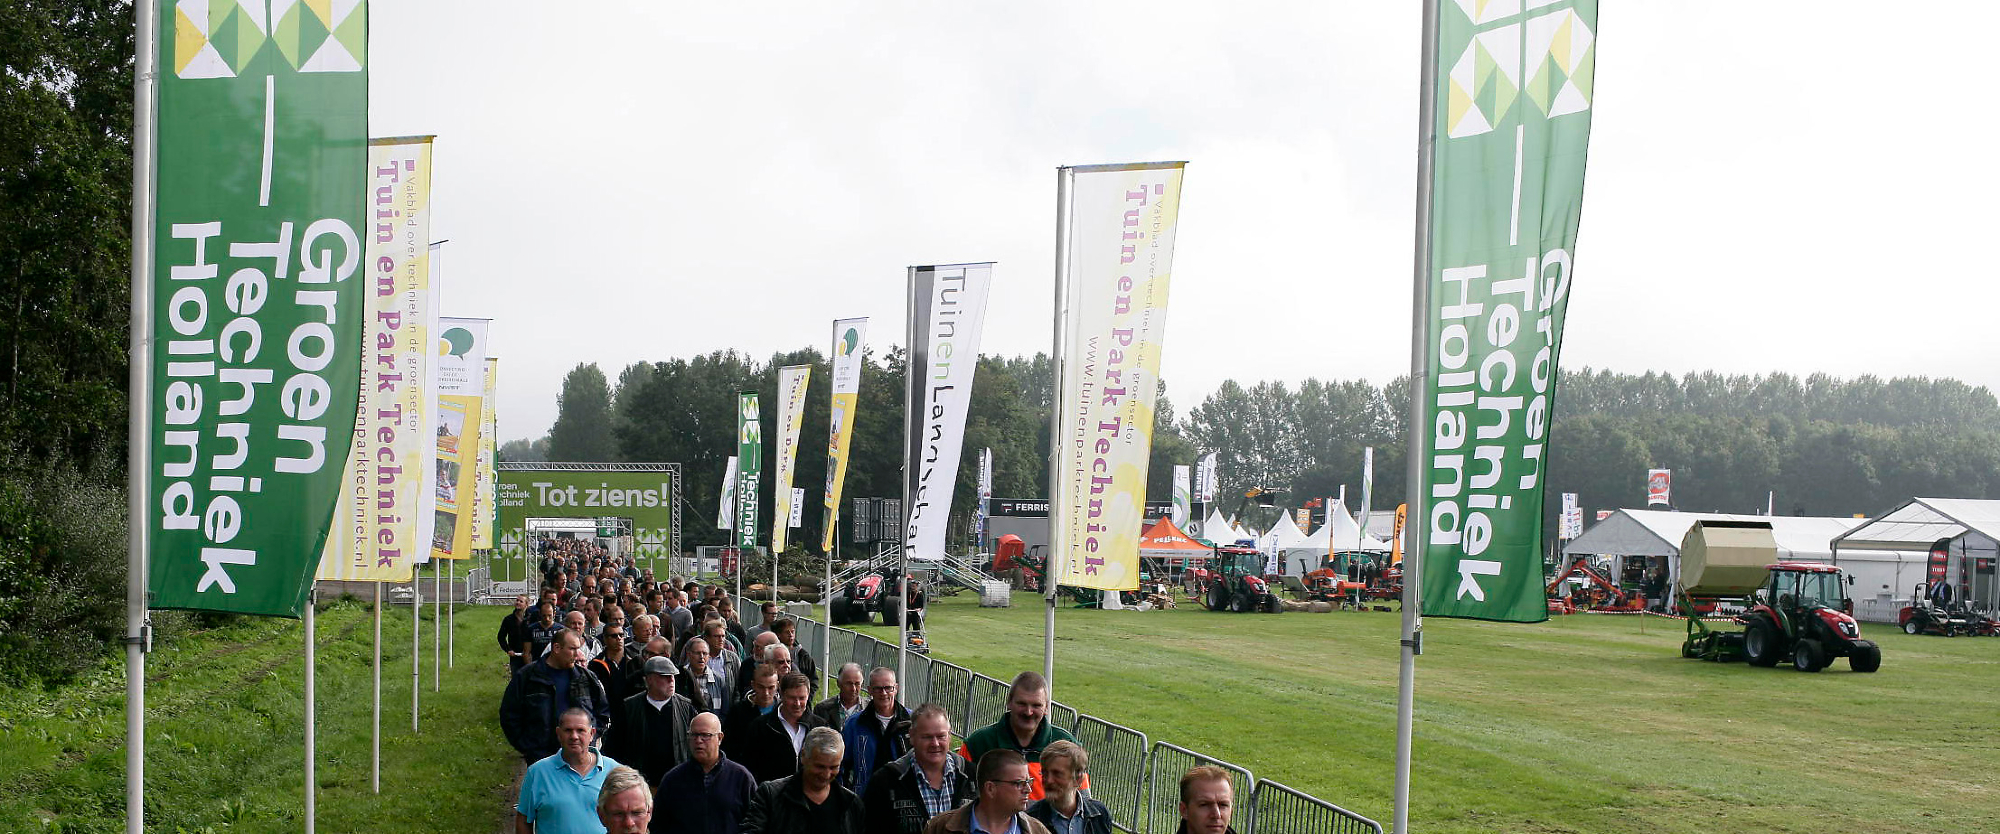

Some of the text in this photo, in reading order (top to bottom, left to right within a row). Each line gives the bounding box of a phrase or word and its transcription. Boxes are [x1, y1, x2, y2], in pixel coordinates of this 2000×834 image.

[162, 220, 222, 531] Holland
[197, 222, 293, 594] Techniek
[275, 217, 361, 474] Groen
[375, 160, 402, 569] Tuin en Park Techniek
[405, 177, 419, 434] Vakblad over techniek in de groensector
[788, 375, 801, 410] Tuin
[1083, 184, 1149, 577] Tuin en Park Techniek
[1125, 200, 1163, 446] Vakblad over techniek in de groensector
[1429, 265, 1487, 545] Holland
[1456, 257, 1536, 602] Techniek
[1520, 248, 1571, 490] Groen
[353, 321, 370, 568] wtuinenparktechniek.nl
[499, 499, 524, 507] olland
[532, 482, 668, 507] Tot ziens!
[743, 472, 759, 546] Techniek
[1016, 503, 1050, 512] FERRIS
